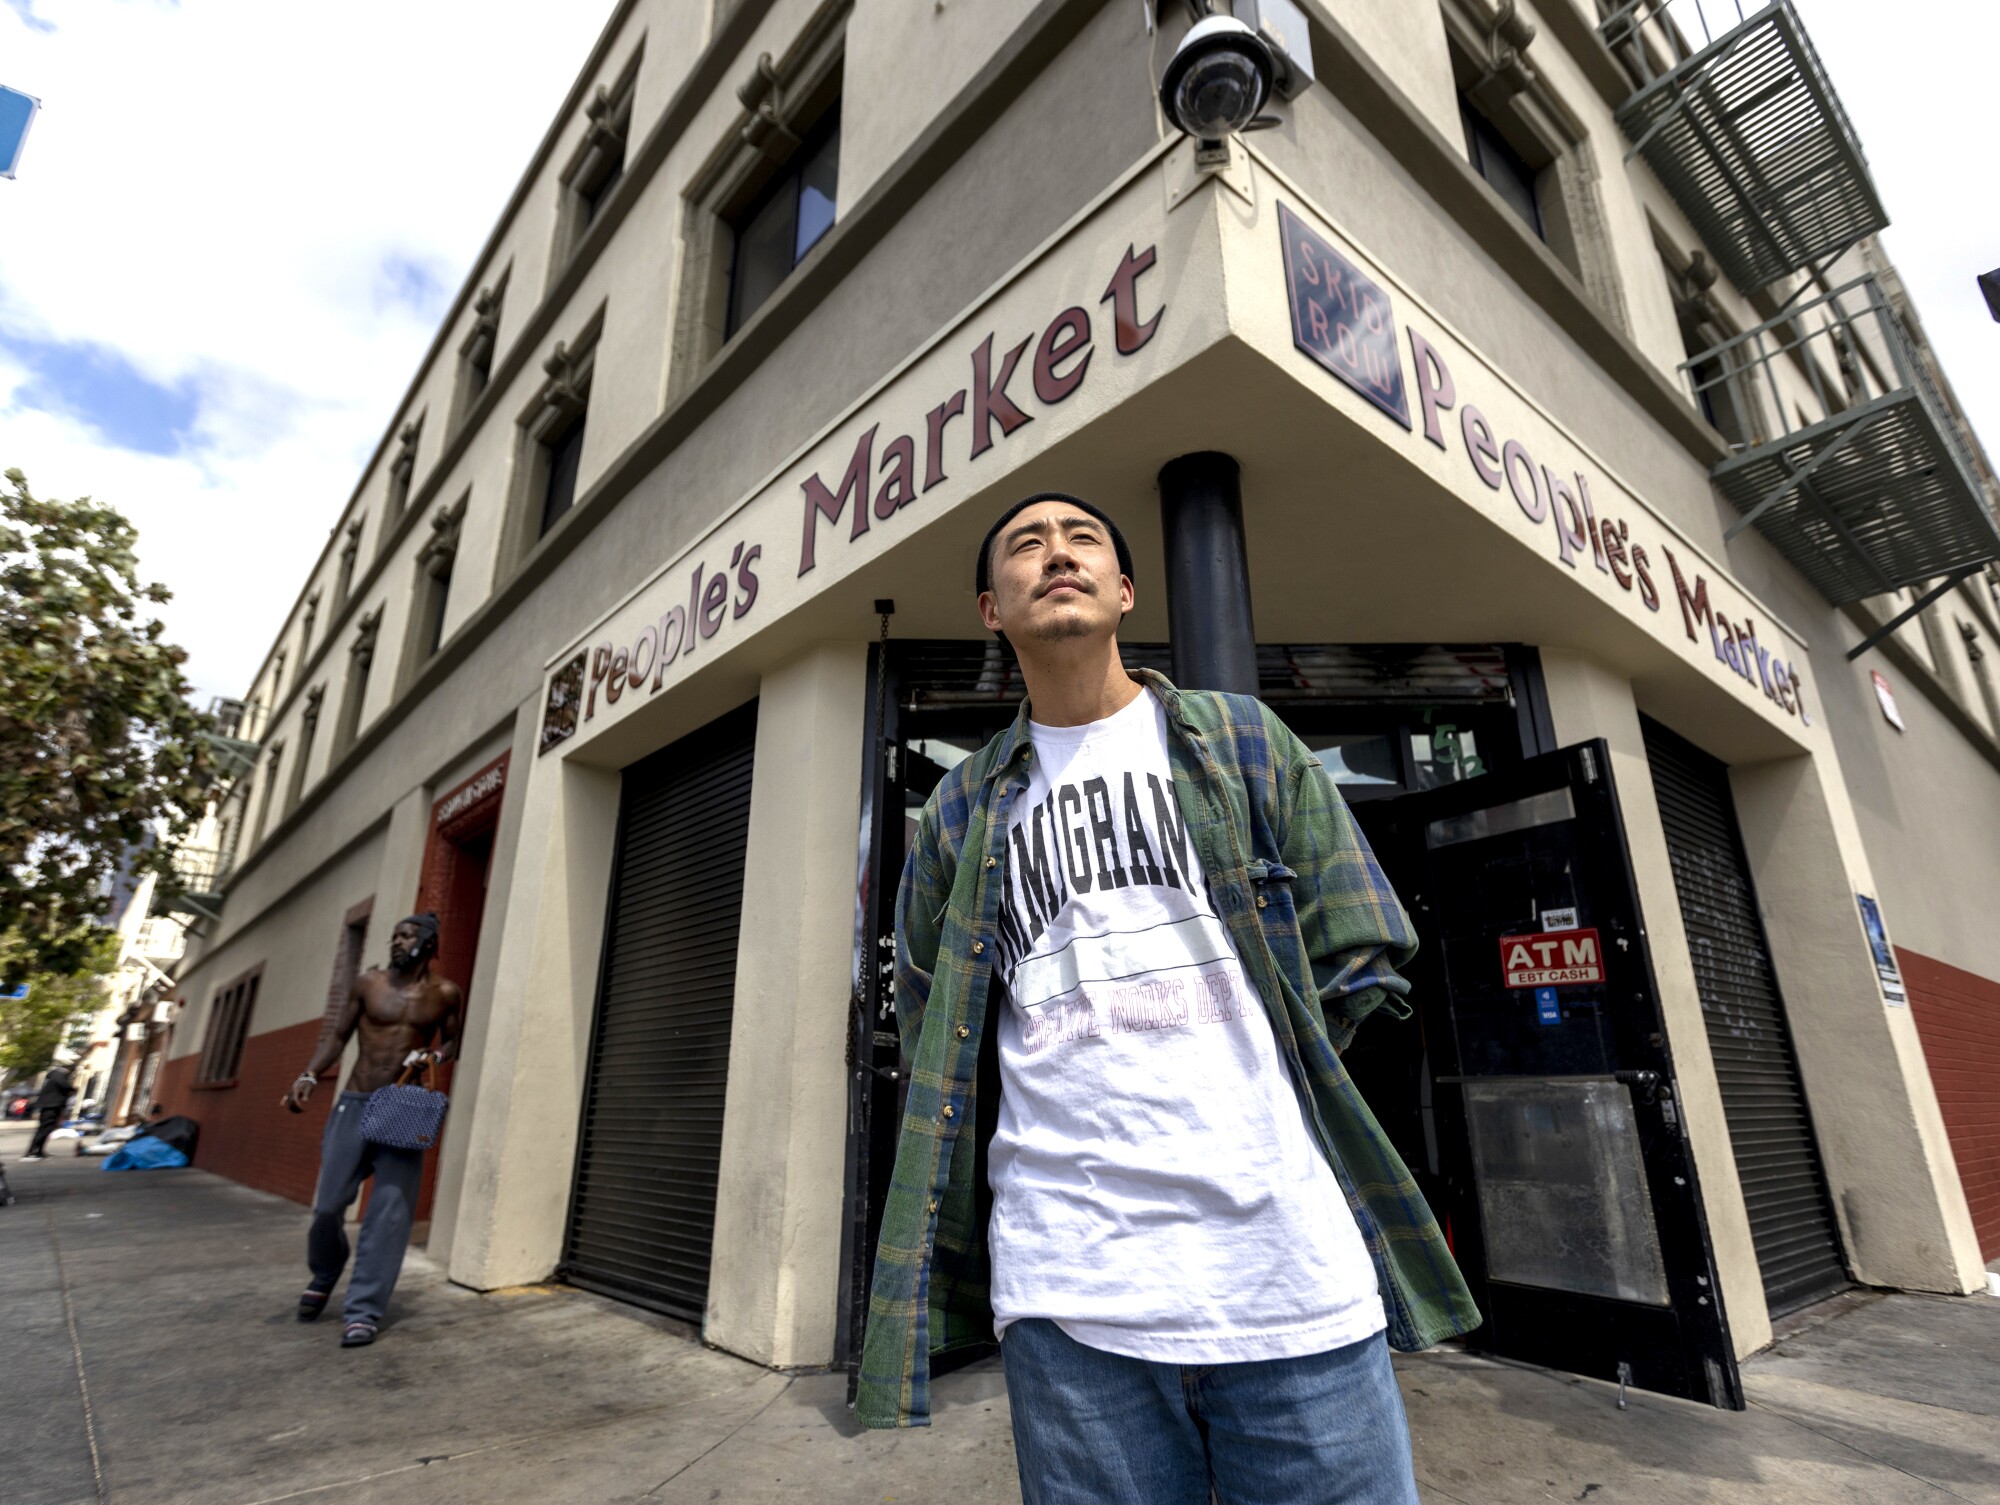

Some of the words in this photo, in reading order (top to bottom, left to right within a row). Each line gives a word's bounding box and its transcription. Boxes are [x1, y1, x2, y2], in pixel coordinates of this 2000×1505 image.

[1301, 241, 1384, 335] SKID
[1307, 297, 1392, 395] ROW
[584, 540, 761, 723] People's
[797, 243, 1166, 579] Market
[1406, 325, 1660, 613] People's
[1662, 545, 1812, 727] Market
[1507, 937, 1597, 970] ATM
[1518, 972, 1545, 984] EBT
[1549, 969, 1590, 982] CASH
[1108, 979, 1189, 1035] WORKS
